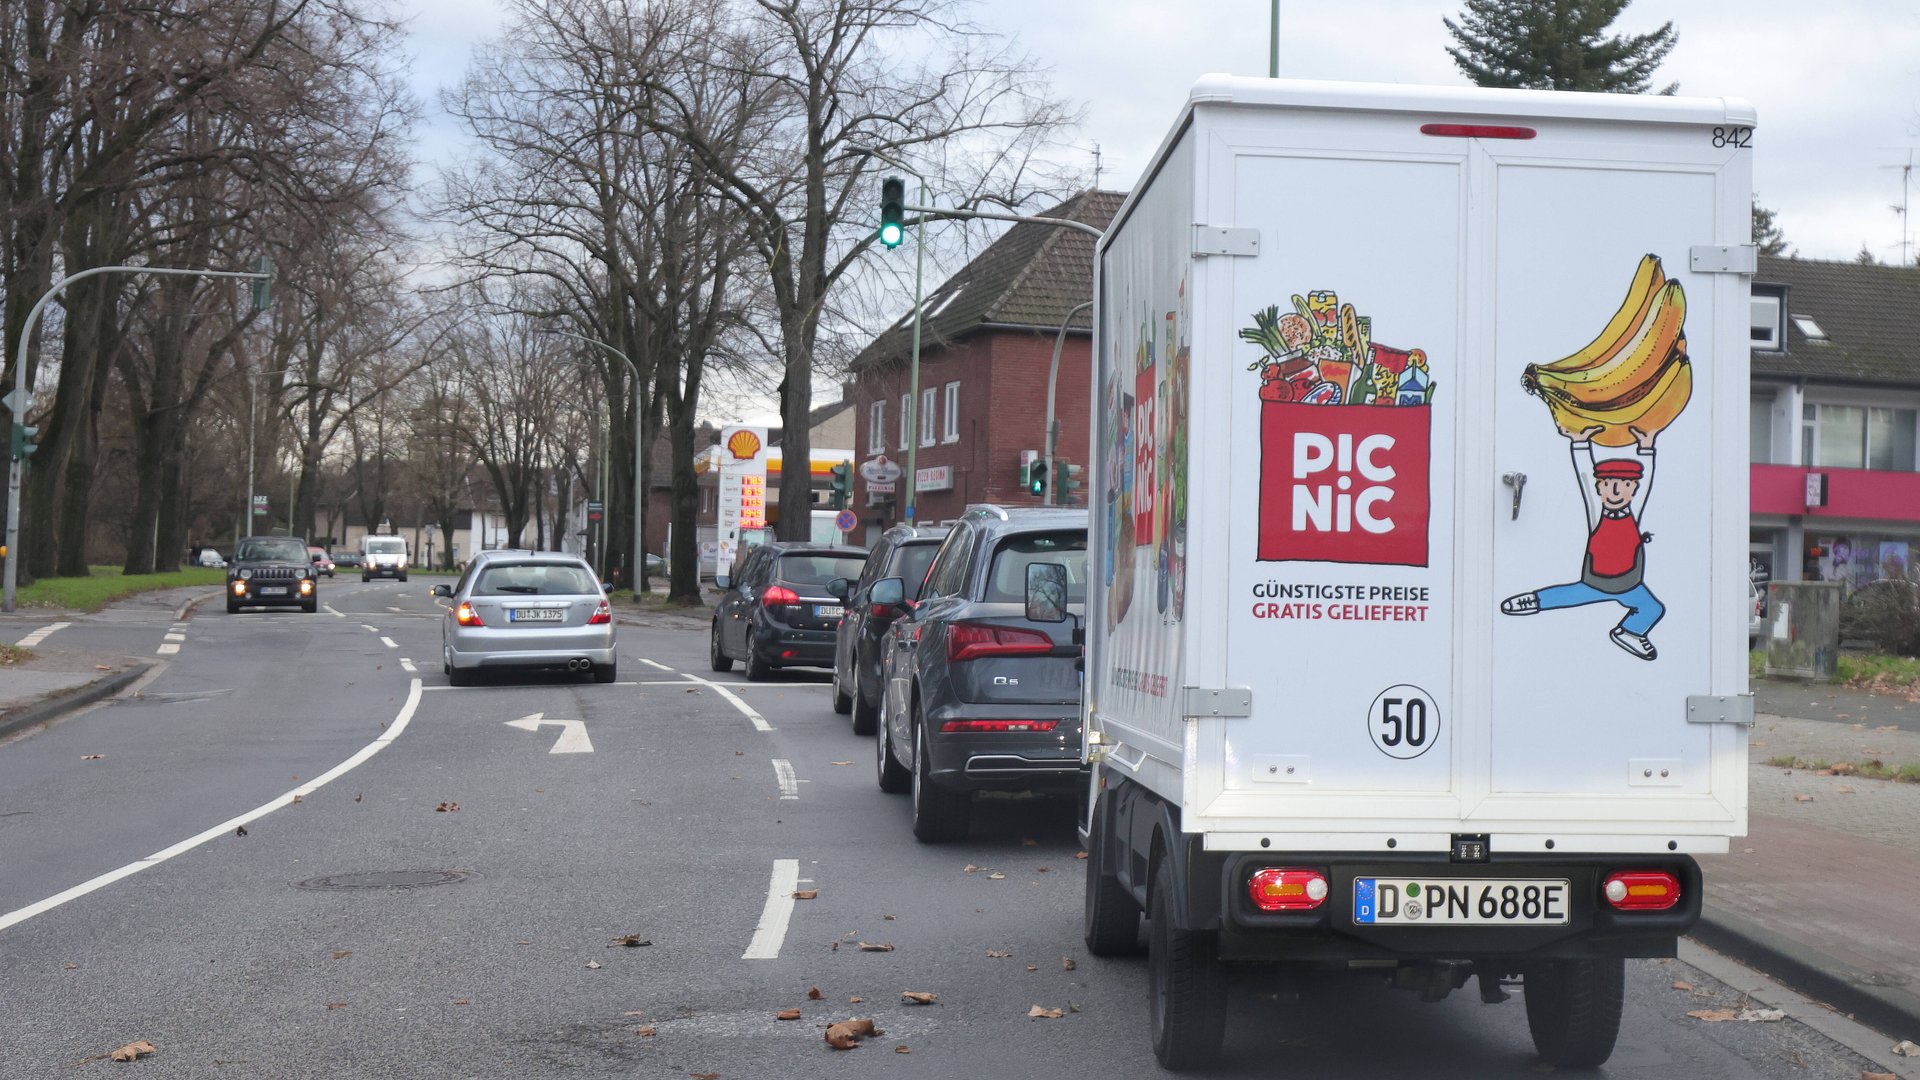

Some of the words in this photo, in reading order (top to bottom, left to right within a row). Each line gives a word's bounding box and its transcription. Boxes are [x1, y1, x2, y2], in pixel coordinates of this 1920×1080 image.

[1712, 126, 1752, 148] 842
[1252, 579, 1365, 599] GÜNSTIGSTE
[1369, 586, 1430, 601] PREISE
[516, 610, 525, 619] DU
[543, 610, 562, 619] 1375
[1252, 602, 1323, 620] GRATIS
[1327, 603, 1429, 622] GELIEFERT
[993, 676, 1019, 686] Q5
[1382, 697, 1426, 747] 50
[1361, 905, 1370, 915] D
[1377, 884, 1399, 918] D
[1425, 885, 1469, 919] PN
[1478, 885, 1564, 919] 688E
